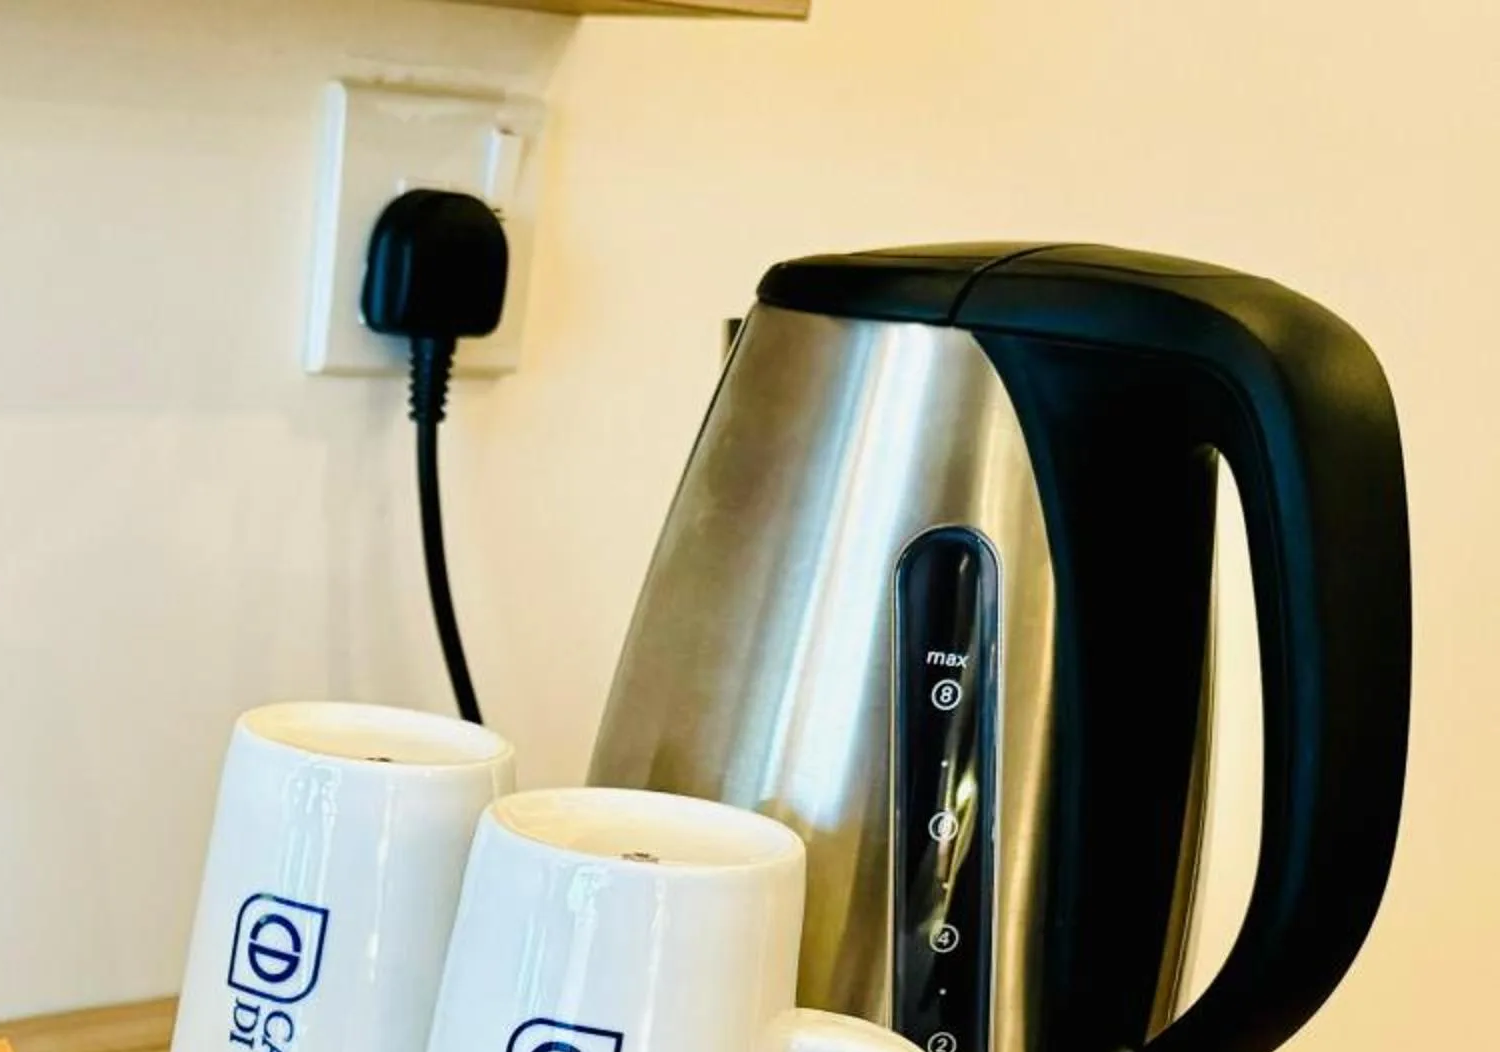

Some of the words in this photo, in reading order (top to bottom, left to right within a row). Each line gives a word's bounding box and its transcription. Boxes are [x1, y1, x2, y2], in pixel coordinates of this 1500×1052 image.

[926, 650, 969, 668] max
[939, 685, 953, 703] 8
[229, 998, 260, 1049] DI
